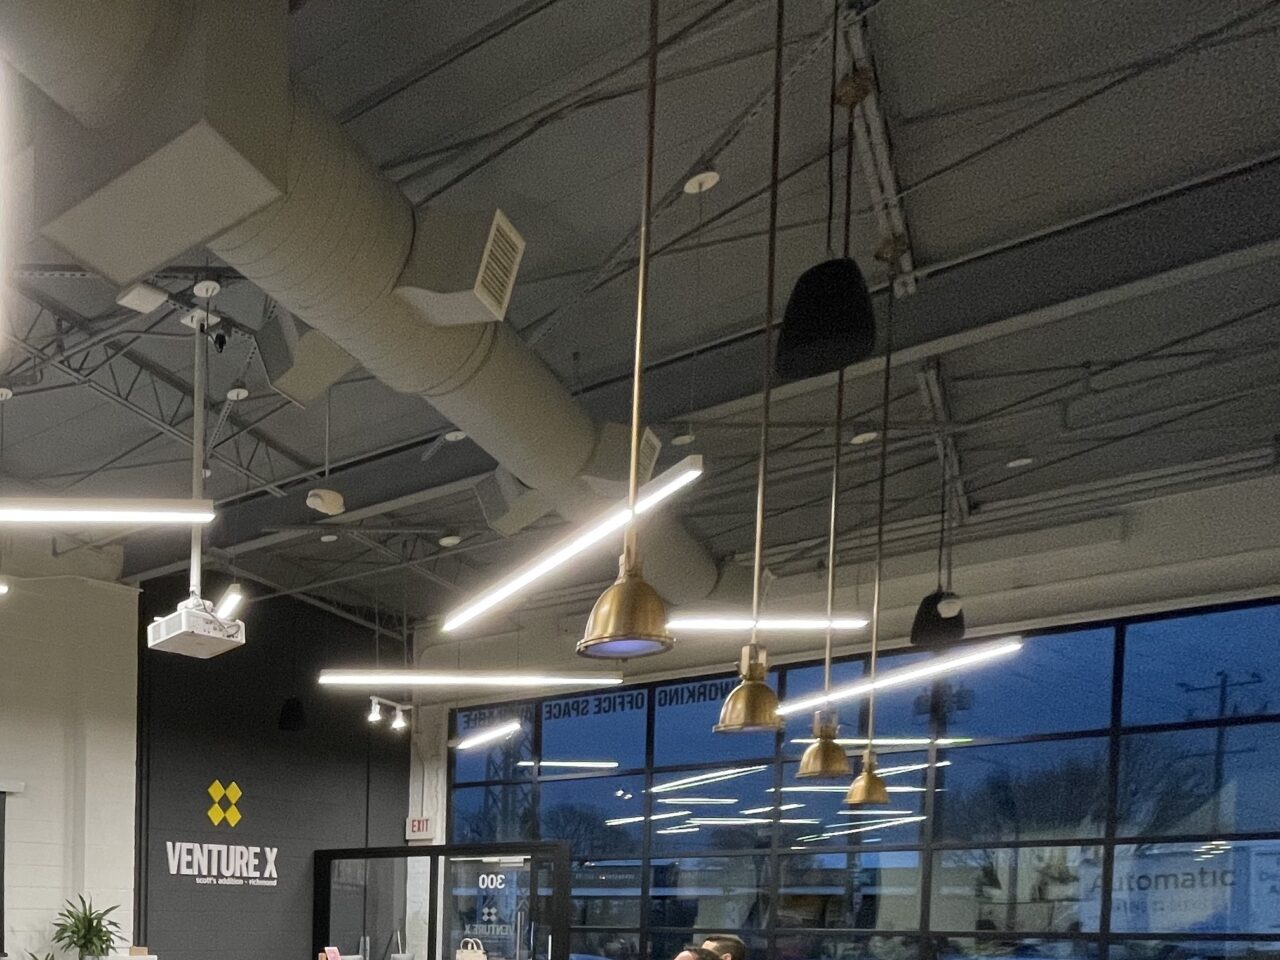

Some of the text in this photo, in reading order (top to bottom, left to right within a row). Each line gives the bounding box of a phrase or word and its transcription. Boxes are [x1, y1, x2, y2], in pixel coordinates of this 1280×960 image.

[411, 819, 429, 833] EXIT
[166, 841, 278, 879] VENTURE X
